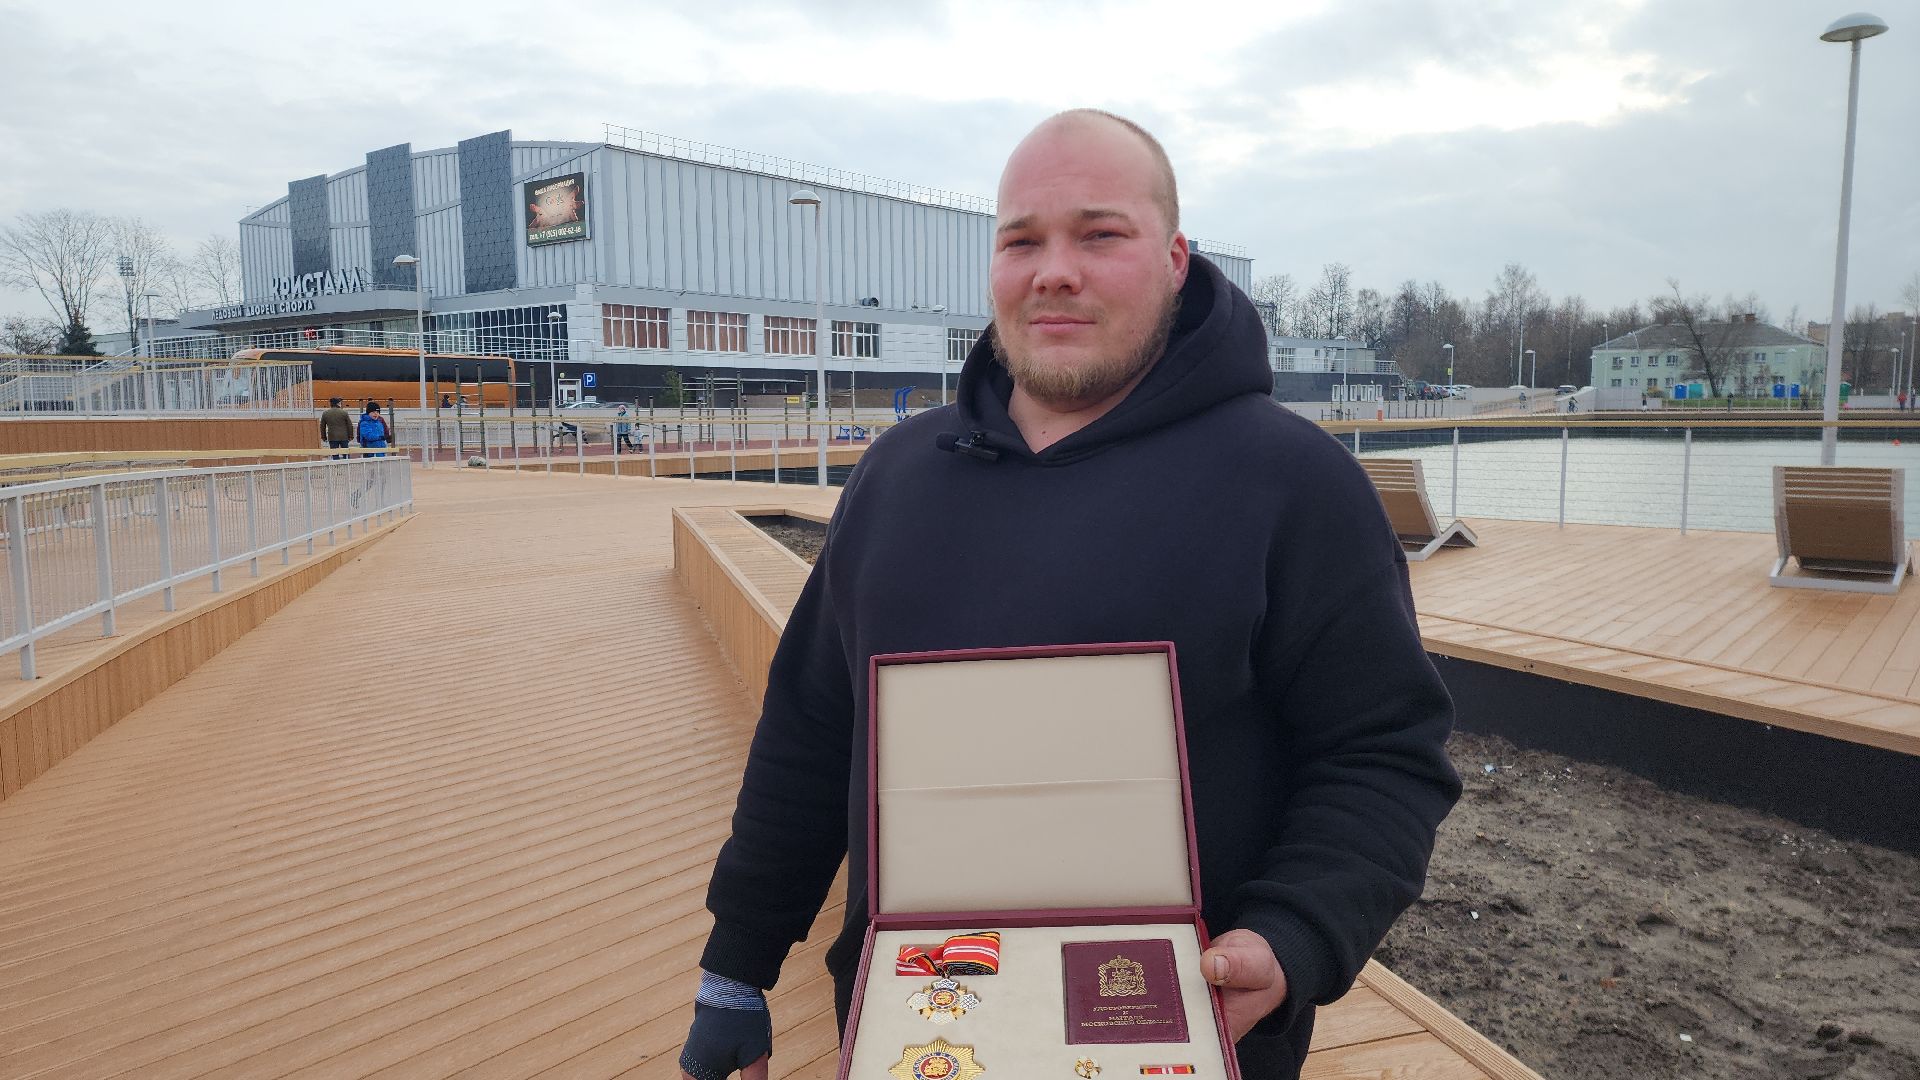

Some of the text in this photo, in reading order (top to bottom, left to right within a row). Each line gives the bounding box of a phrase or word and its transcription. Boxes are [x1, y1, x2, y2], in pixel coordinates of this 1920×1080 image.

[272, 266, 363, 301] КРИСТАЛЛ
[211, 299, 315, 321] ЛЕДОВЫЙ ДВОРЕЦ СПОРТА
[586, 374, 594, 386] P
